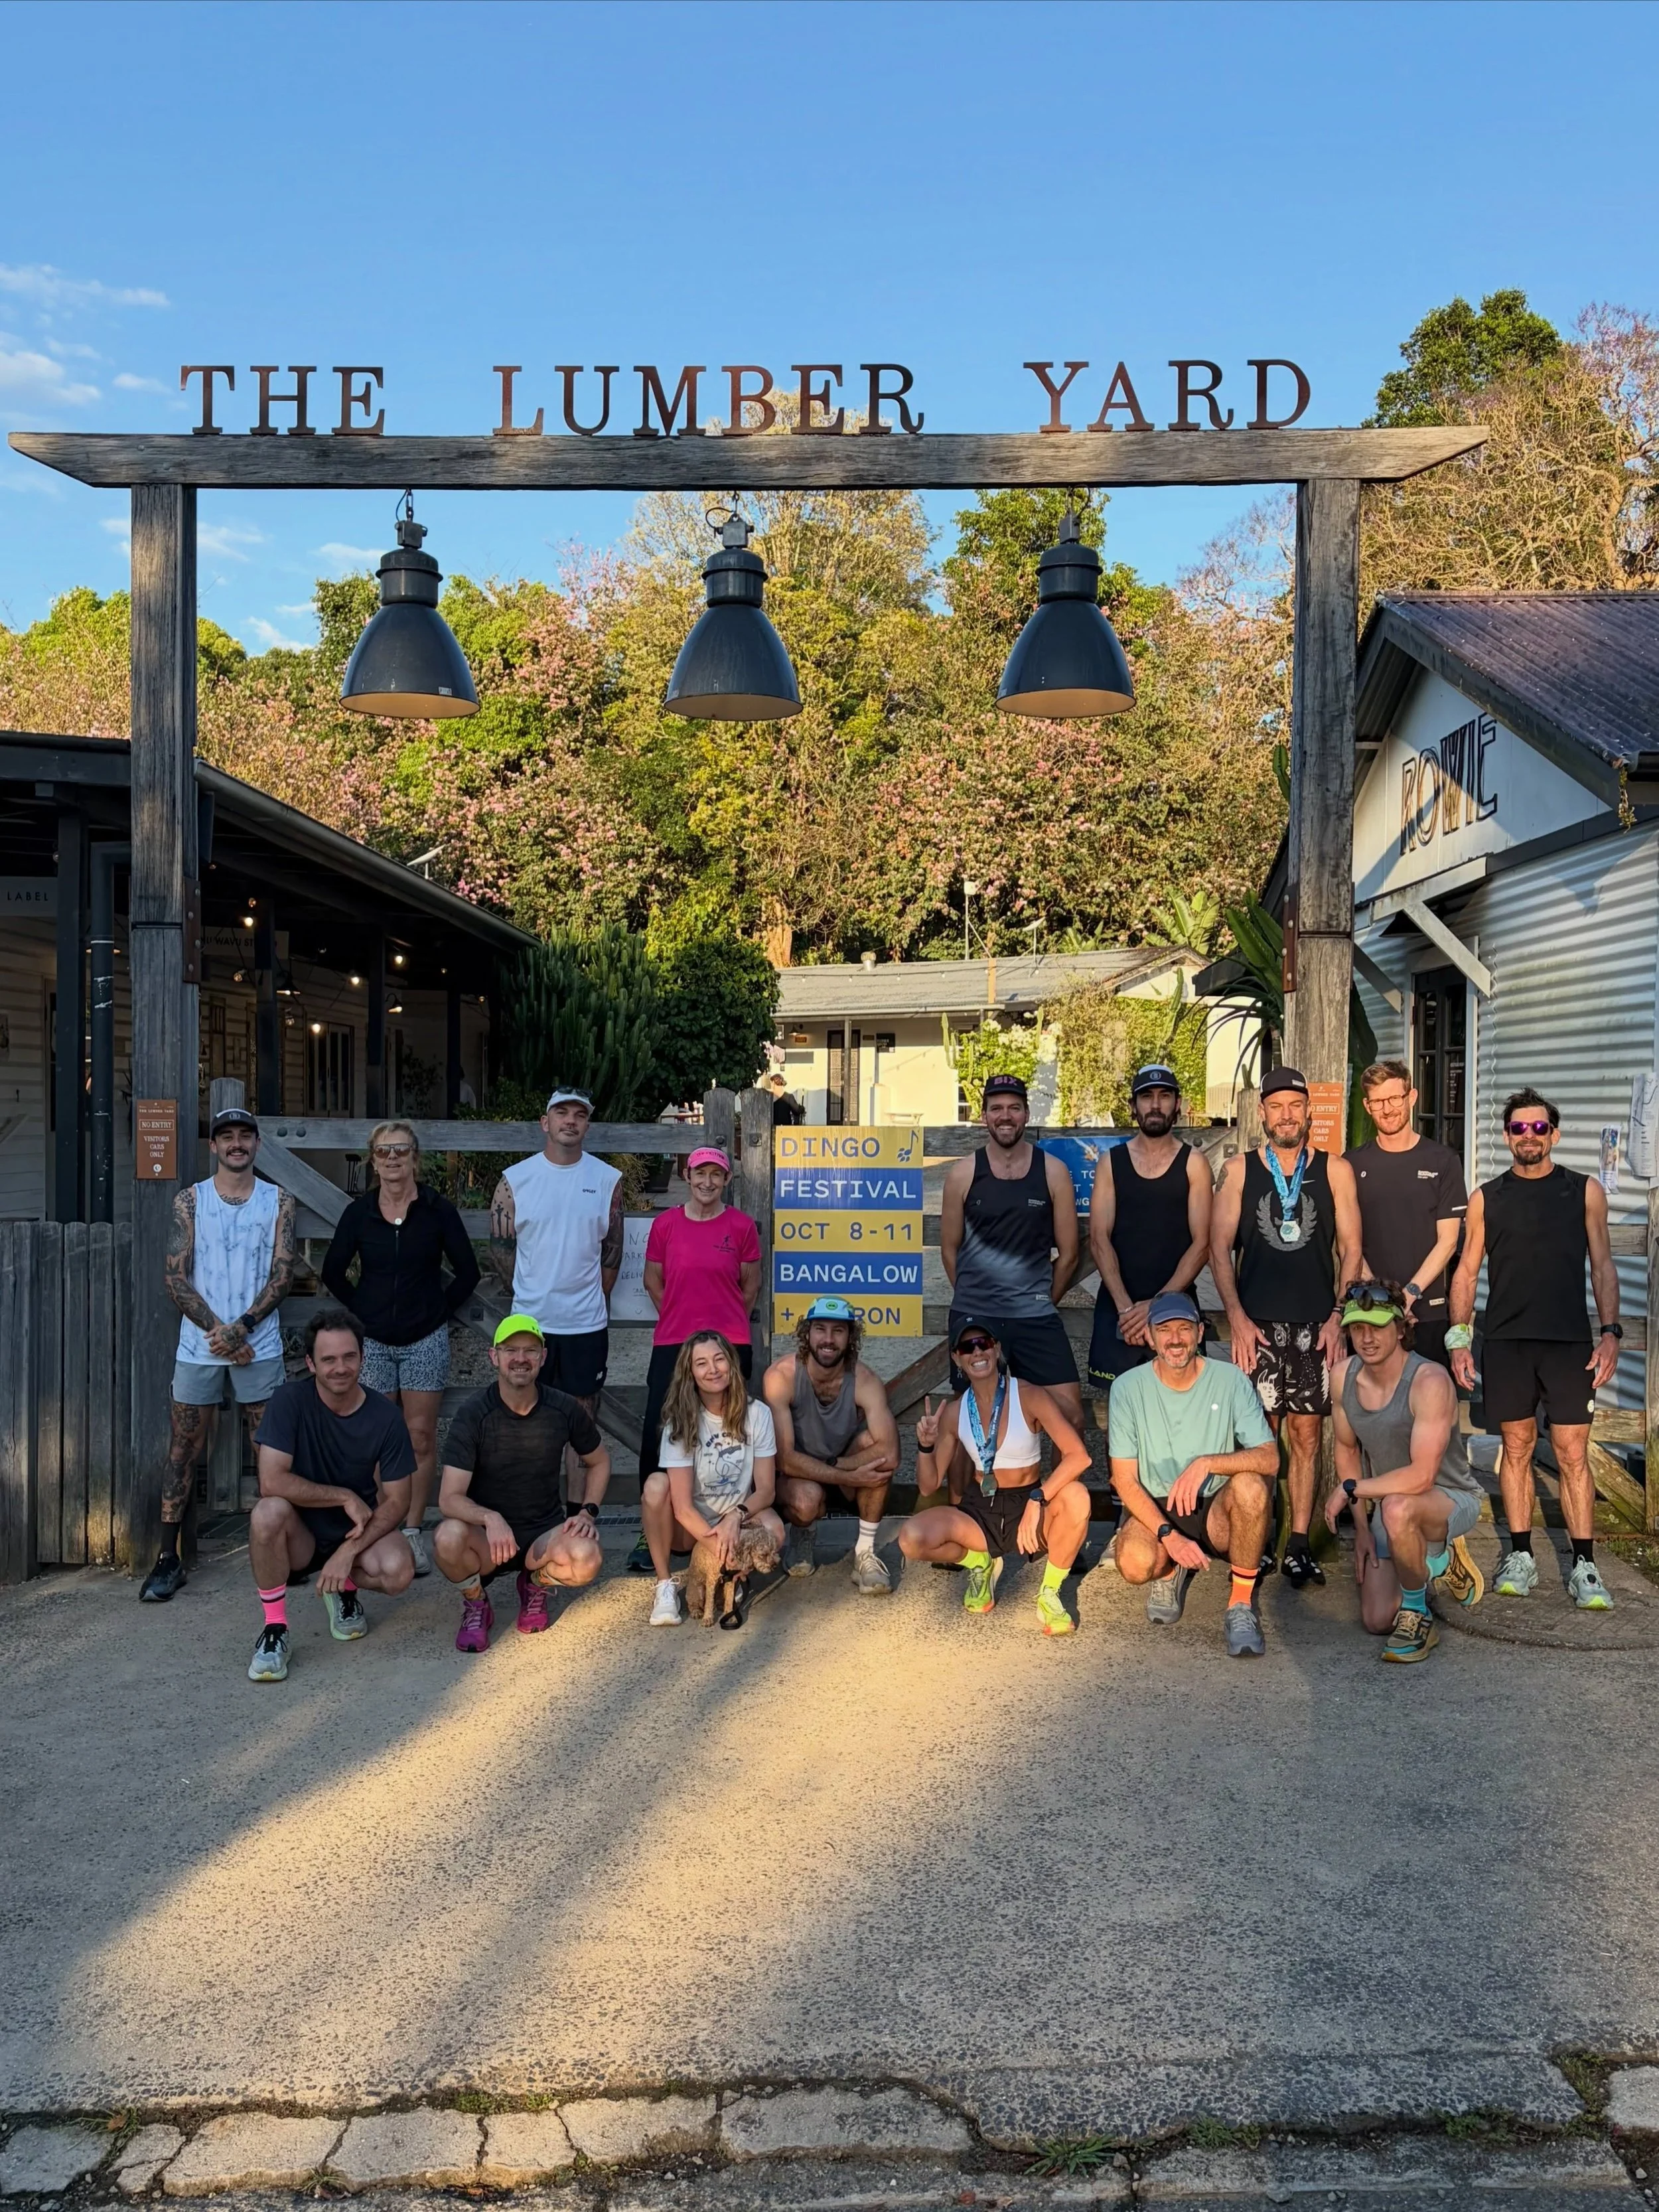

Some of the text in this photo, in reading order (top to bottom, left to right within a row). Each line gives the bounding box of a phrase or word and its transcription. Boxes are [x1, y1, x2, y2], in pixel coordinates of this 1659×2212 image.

[180, 359, 1311, 436] THE LUMBER YARD
[7, 891, 48, 901] LABEL
[781, 1138, 880, 1157] DINGO
[780, 1180, 916, 1198] FESTIVAL
[780, 1222, 830, 1240] OCT
[780, 1264, 918, 1283] BANGALOW
[853, 1307, 901, 1324] RON
